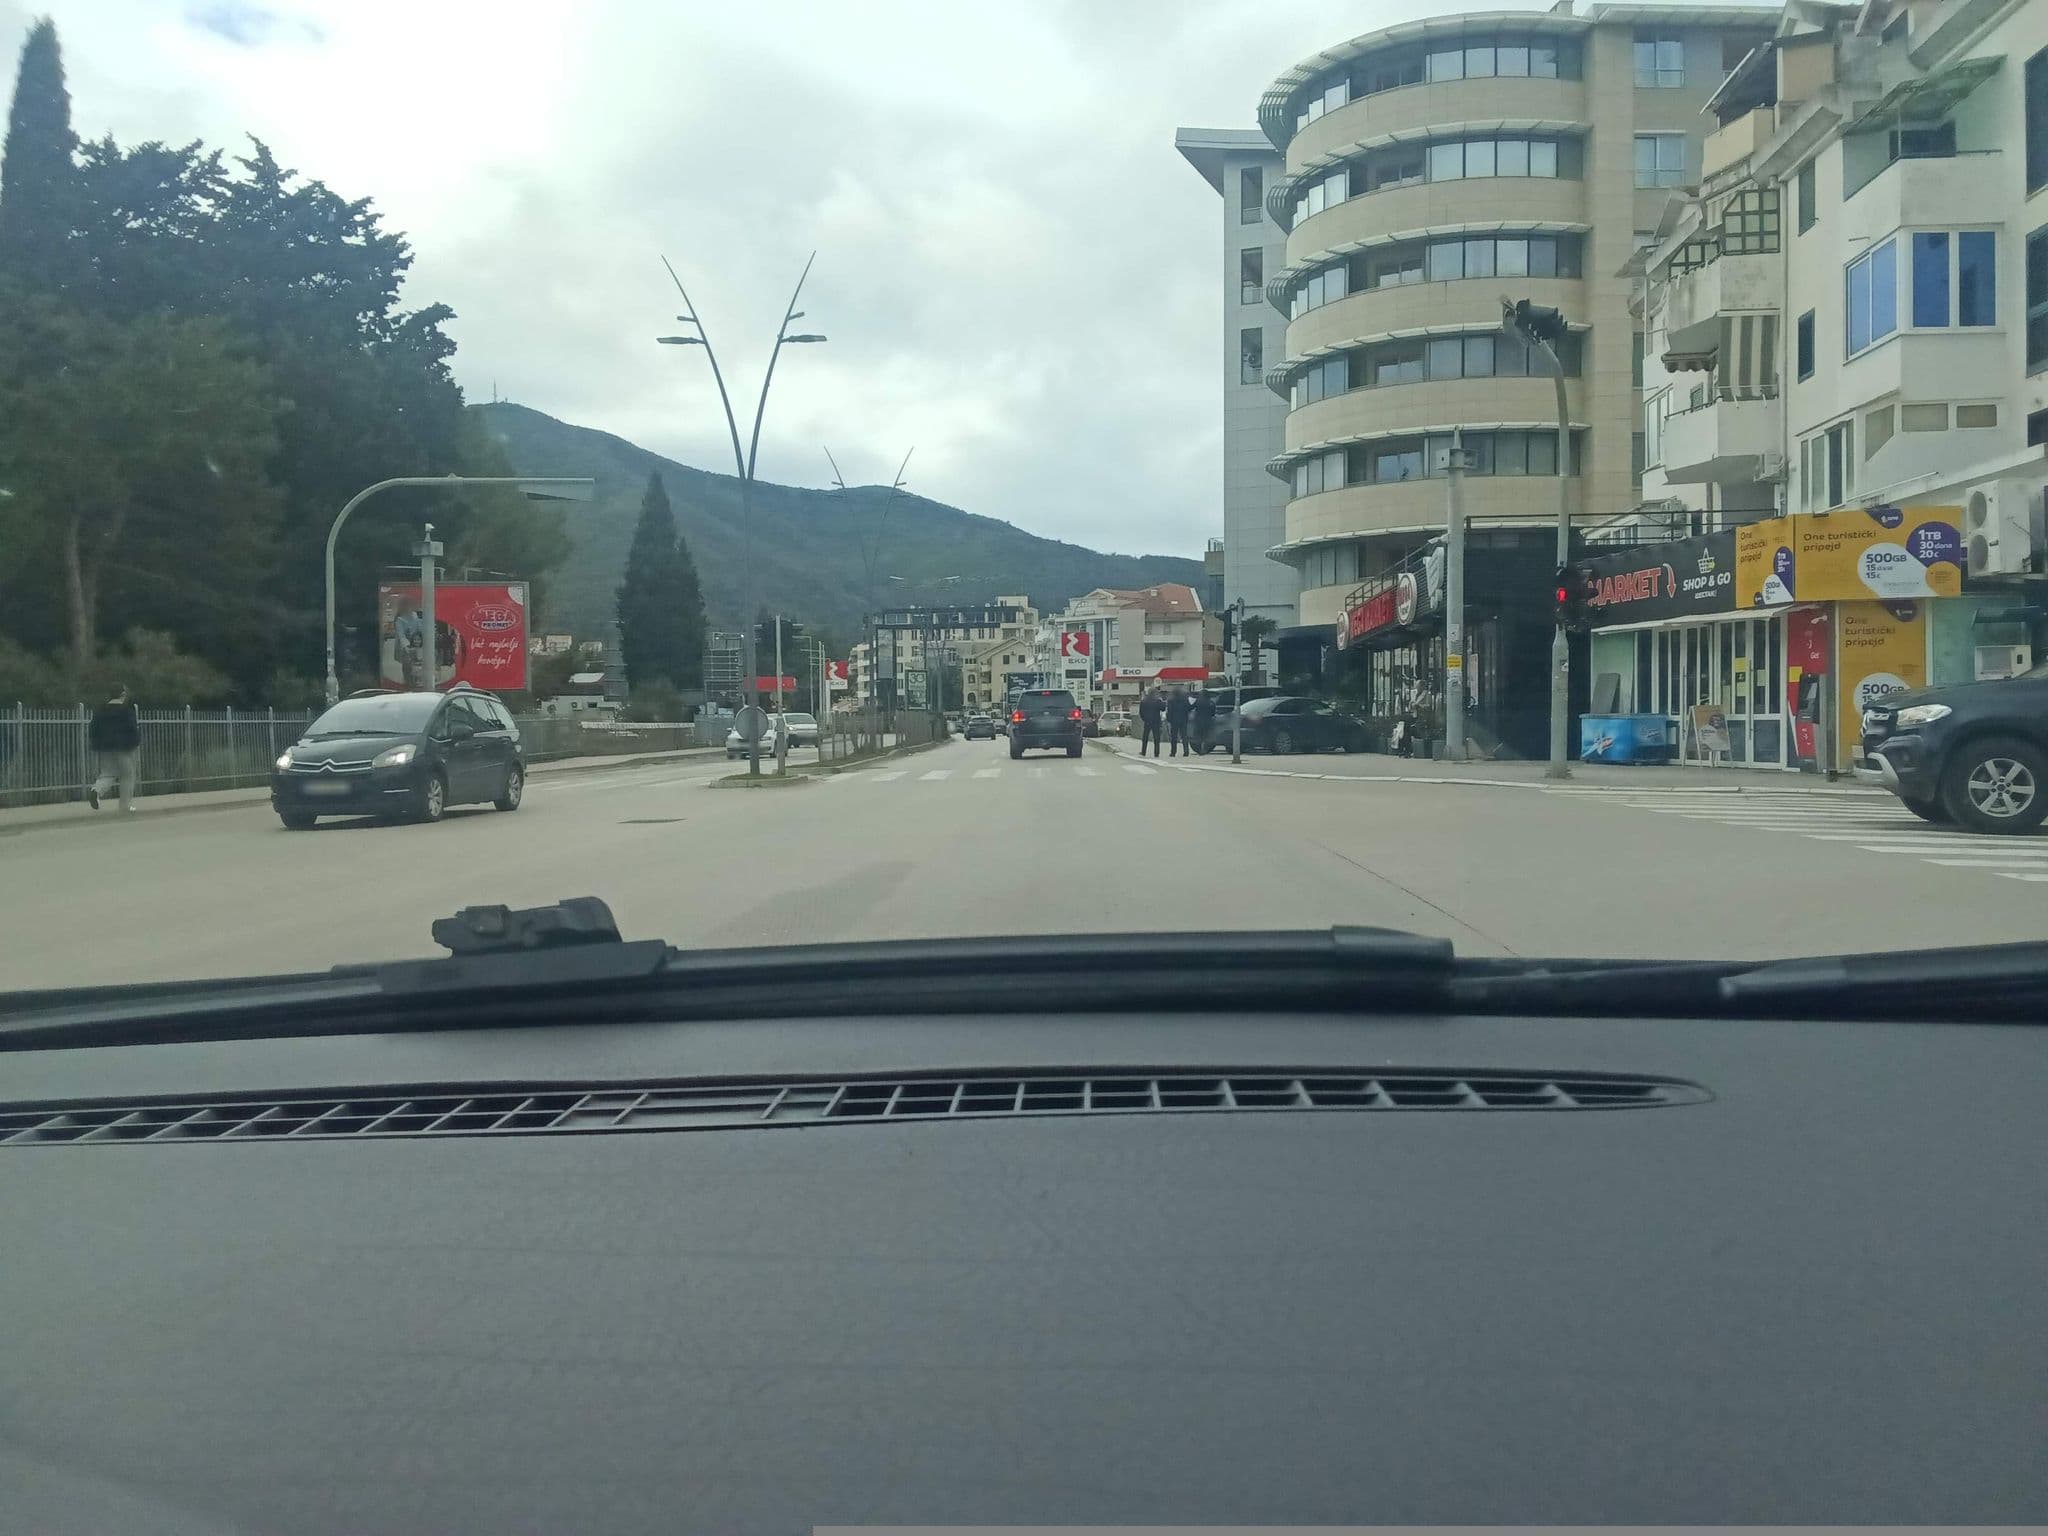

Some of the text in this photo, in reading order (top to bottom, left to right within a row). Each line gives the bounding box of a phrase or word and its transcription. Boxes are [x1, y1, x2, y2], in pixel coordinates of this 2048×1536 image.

[1740, 532, 1753, 540] One
[1803, 530, 1877, 542] One turistički
[1918, 529, 1942, 541] 1TB
[1803, 543, 1841, 553] pripejd
[1919, 541, 1934, 550] 30
[1866, 553, 1907, 563] 500GB
[1682, 571, 1731, 591] SHOP & GO
[1845, 637, 1885, 647] pripejd
